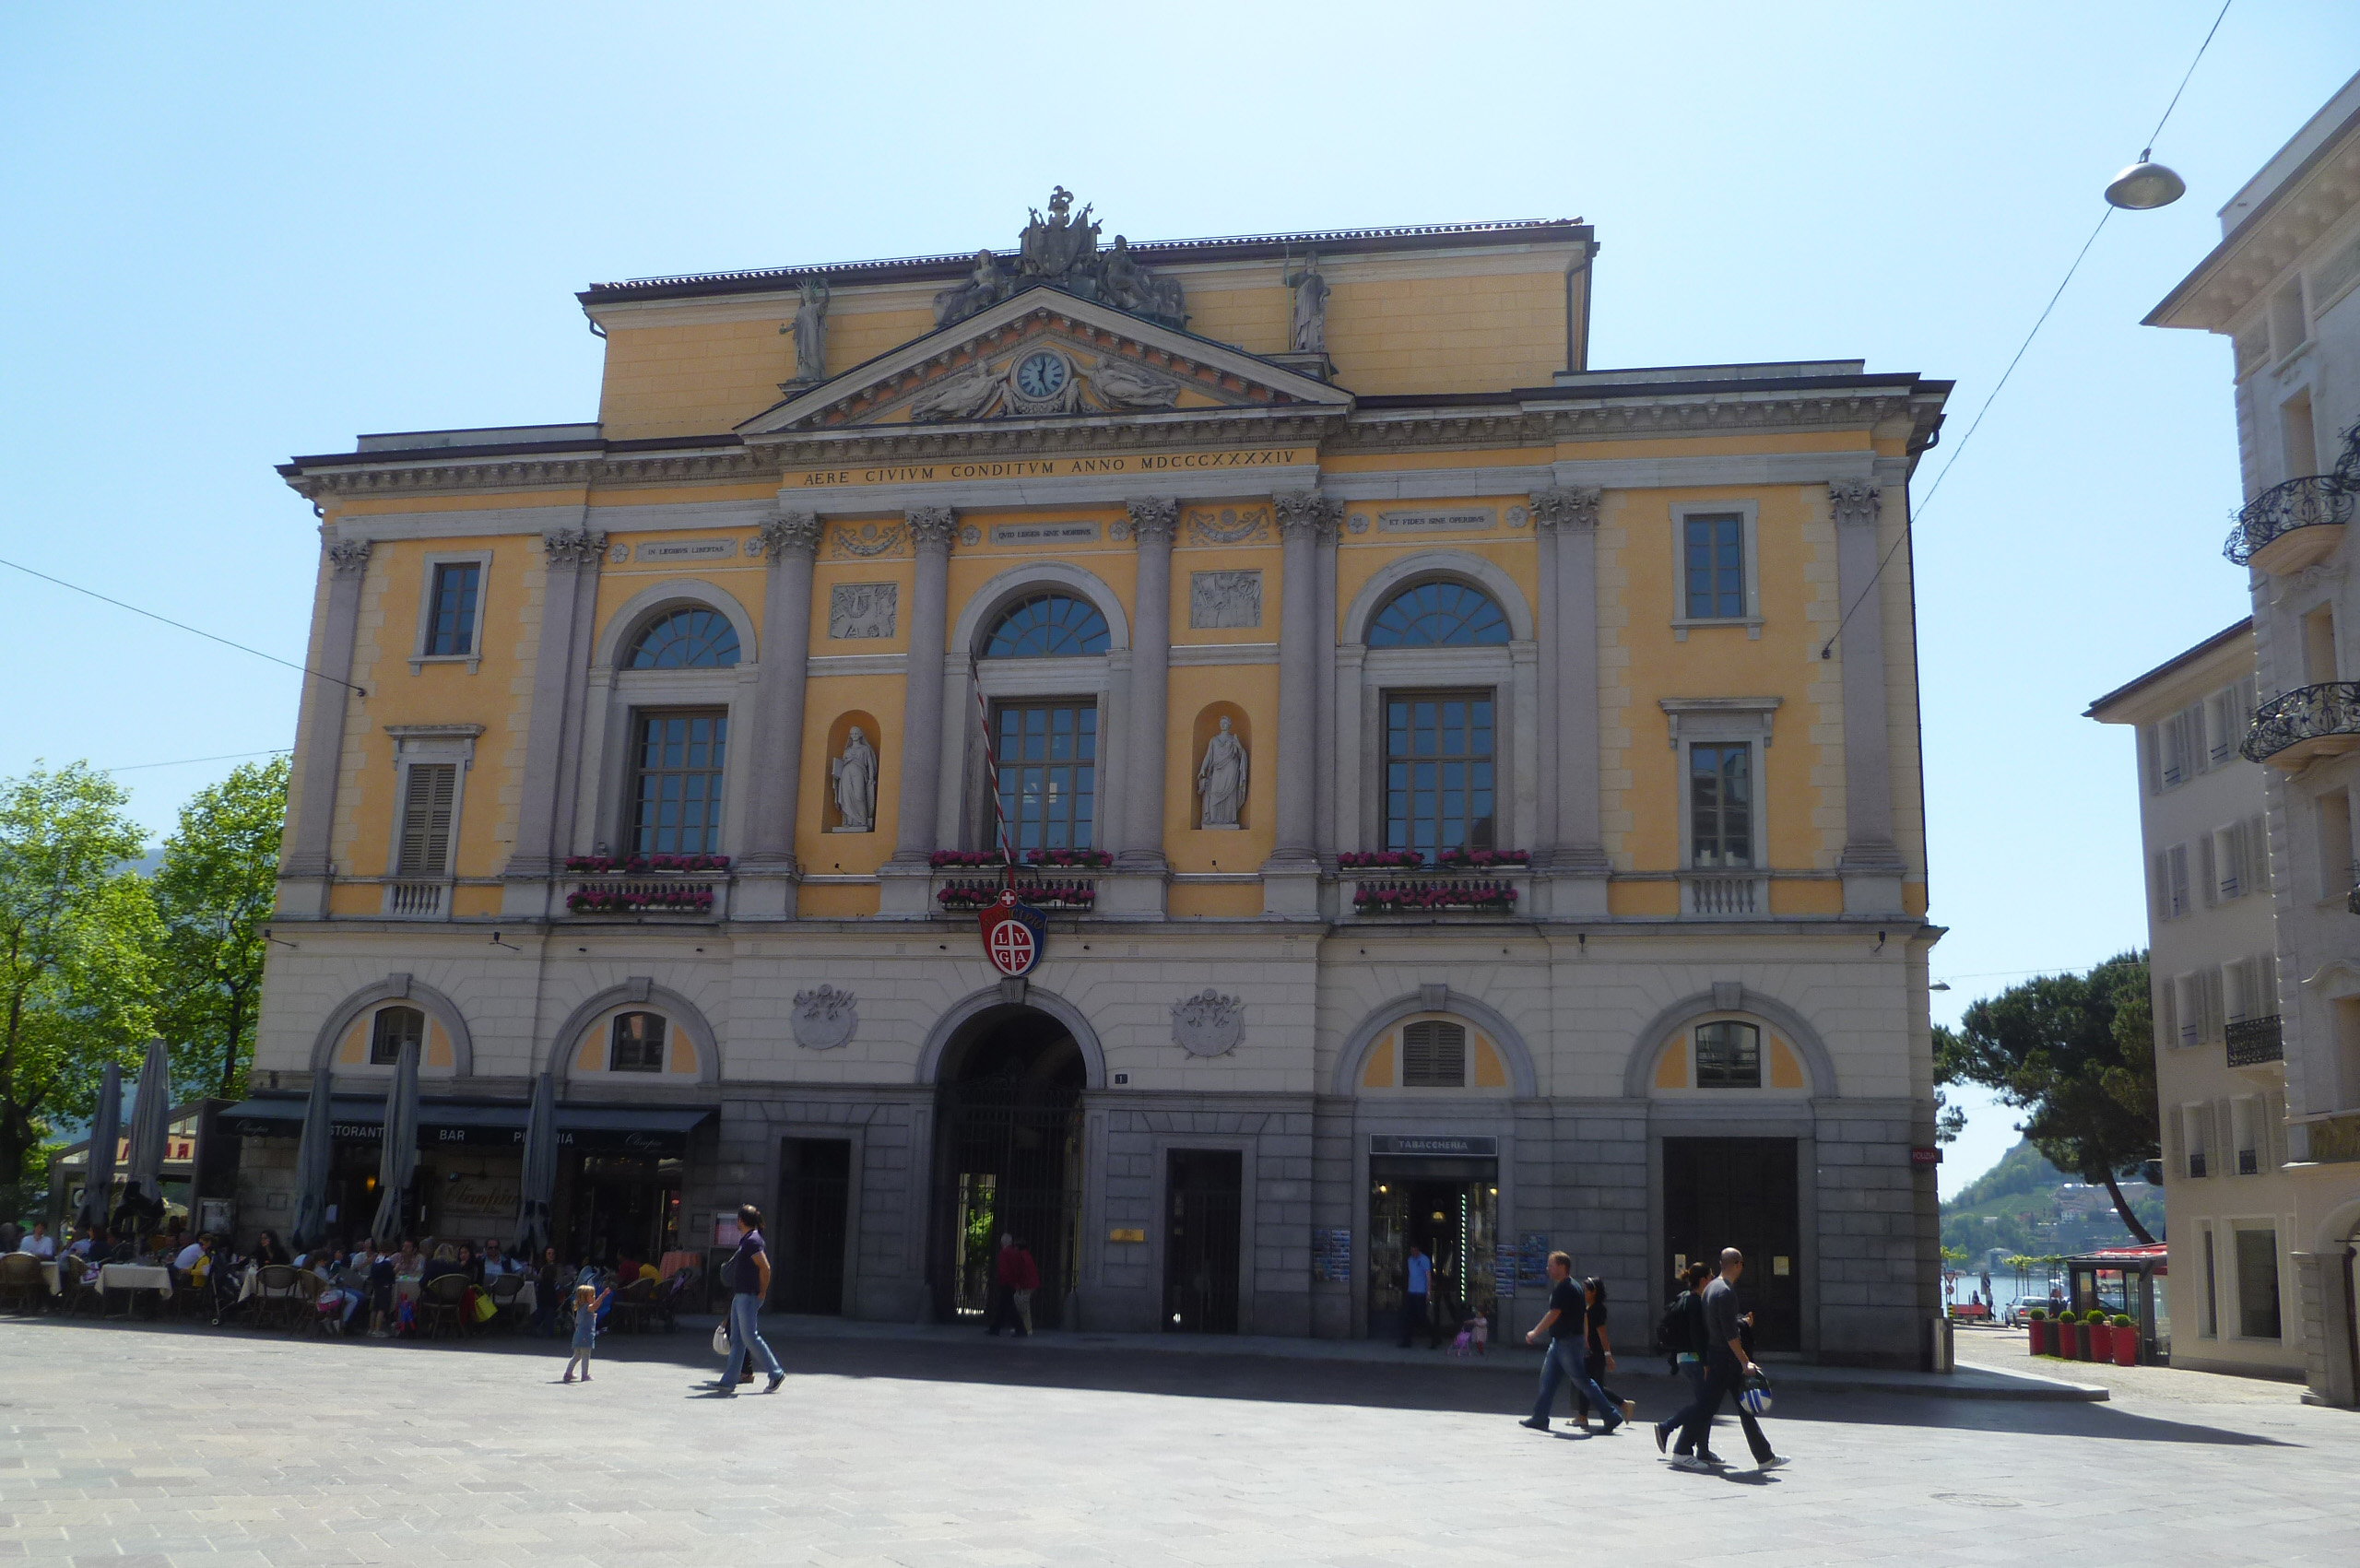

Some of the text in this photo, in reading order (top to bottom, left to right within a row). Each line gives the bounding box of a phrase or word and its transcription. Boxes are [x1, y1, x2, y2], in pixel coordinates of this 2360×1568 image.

[804, 451, 1294, 486] AERE CIVIVM CONDITVM ANNO MDCCCXXXXIV
[997, 932, 1025, 944] L V
[998, 951, 1027, 963] G A
[439, 1129, 466, 1141] BAR
[1399, 1140, 1468, 1149] TABACCHERIA
